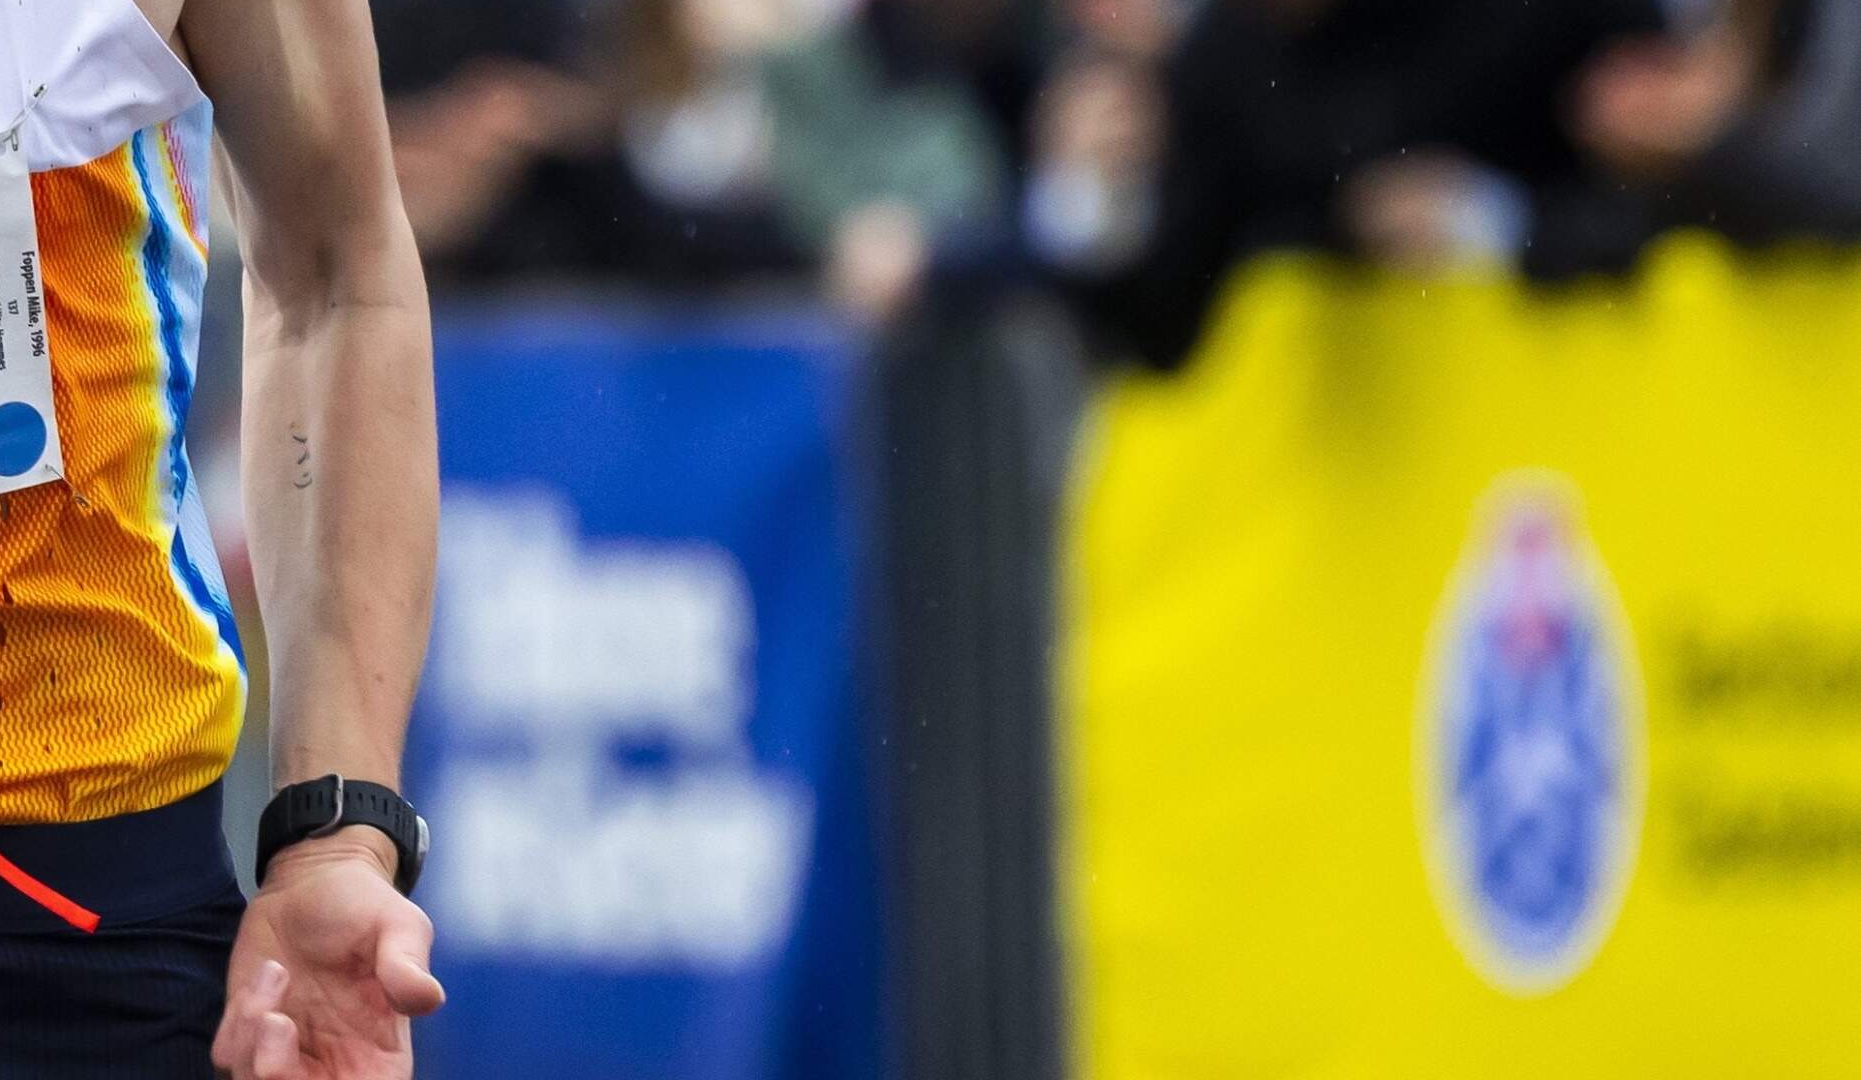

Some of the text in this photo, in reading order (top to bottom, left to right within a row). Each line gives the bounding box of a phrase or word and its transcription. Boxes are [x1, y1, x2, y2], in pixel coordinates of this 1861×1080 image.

[8, 300, 19, 315] 137
[20, 251, 46, 357] Foppen Mike, 1996
